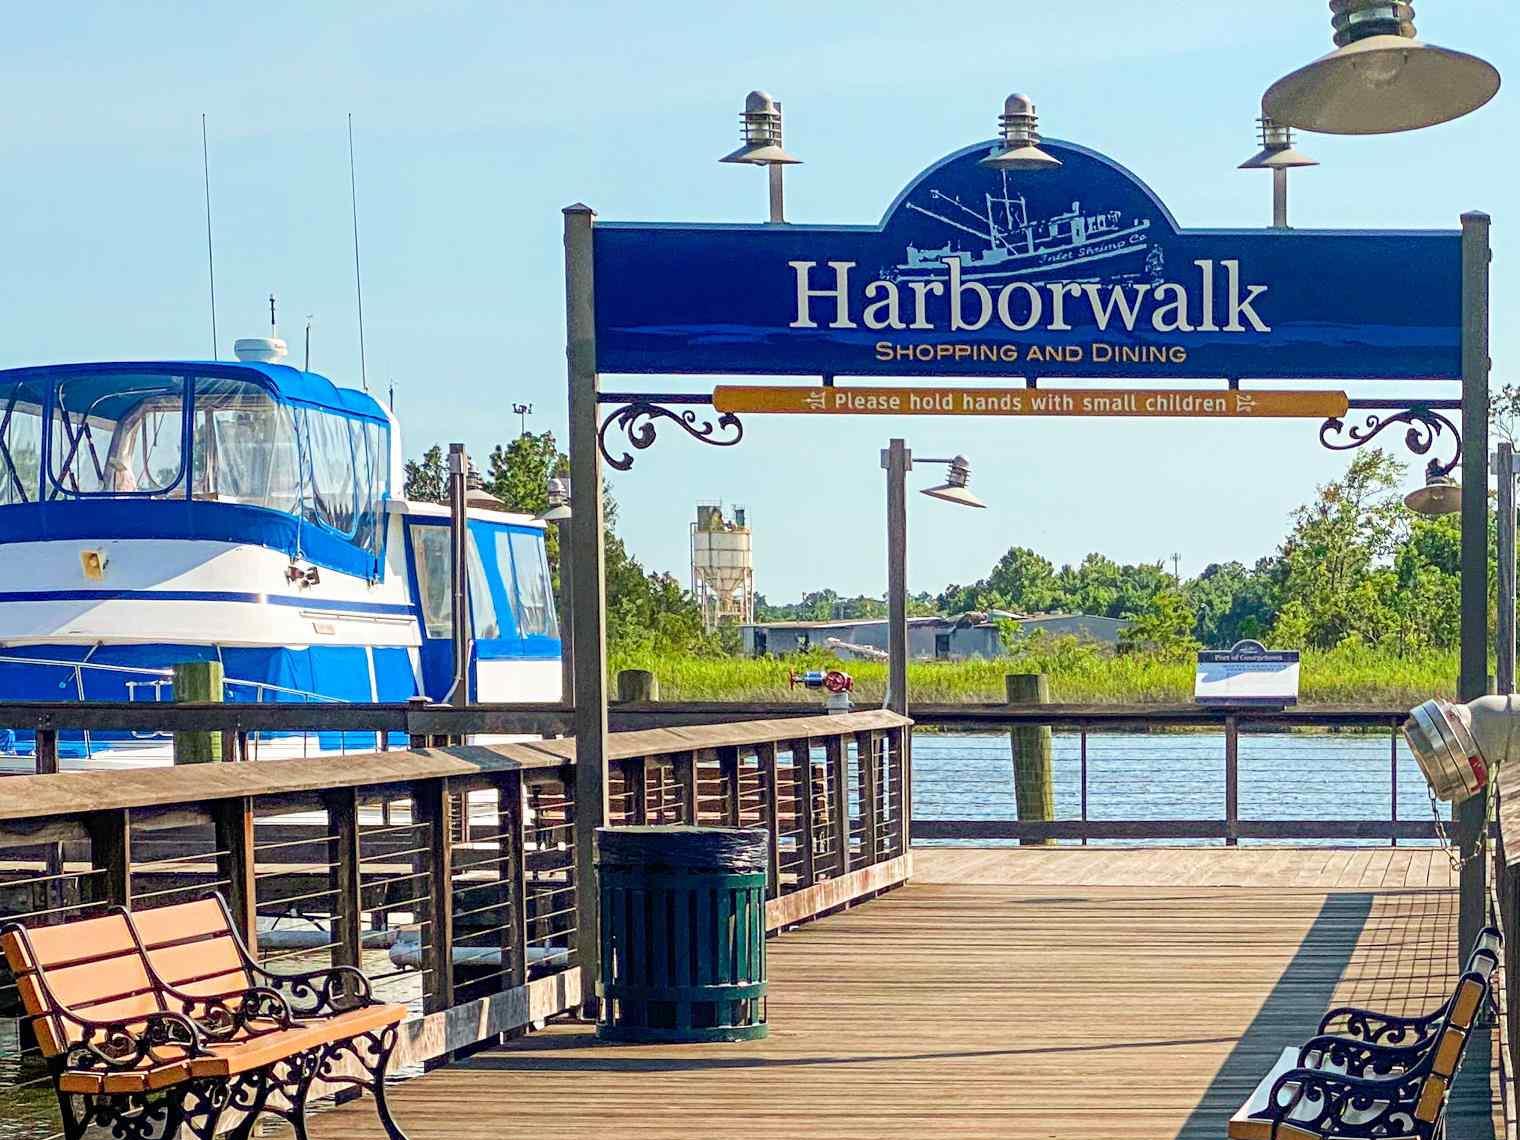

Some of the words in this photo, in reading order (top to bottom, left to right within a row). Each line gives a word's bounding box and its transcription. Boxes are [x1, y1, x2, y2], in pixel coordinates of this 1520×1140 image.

[1078, 240, 1125, 257] Shrimp
[788, 255, 1272, 333] Harborwalk
[875, 341, 1018, 362] SHOPPING
[1026, 345, 1083, 362] AND
[1092, 343, 1187, 363] DINING
[835, 392, 900, 410] Please
[910, 393, 953, 410] hold
[963, 393, 1022, 411] hands
[1031, 394, 1073, 411] with
[1083, 394, 1137, 411] small
[1145, 394, 1227, 412] children
